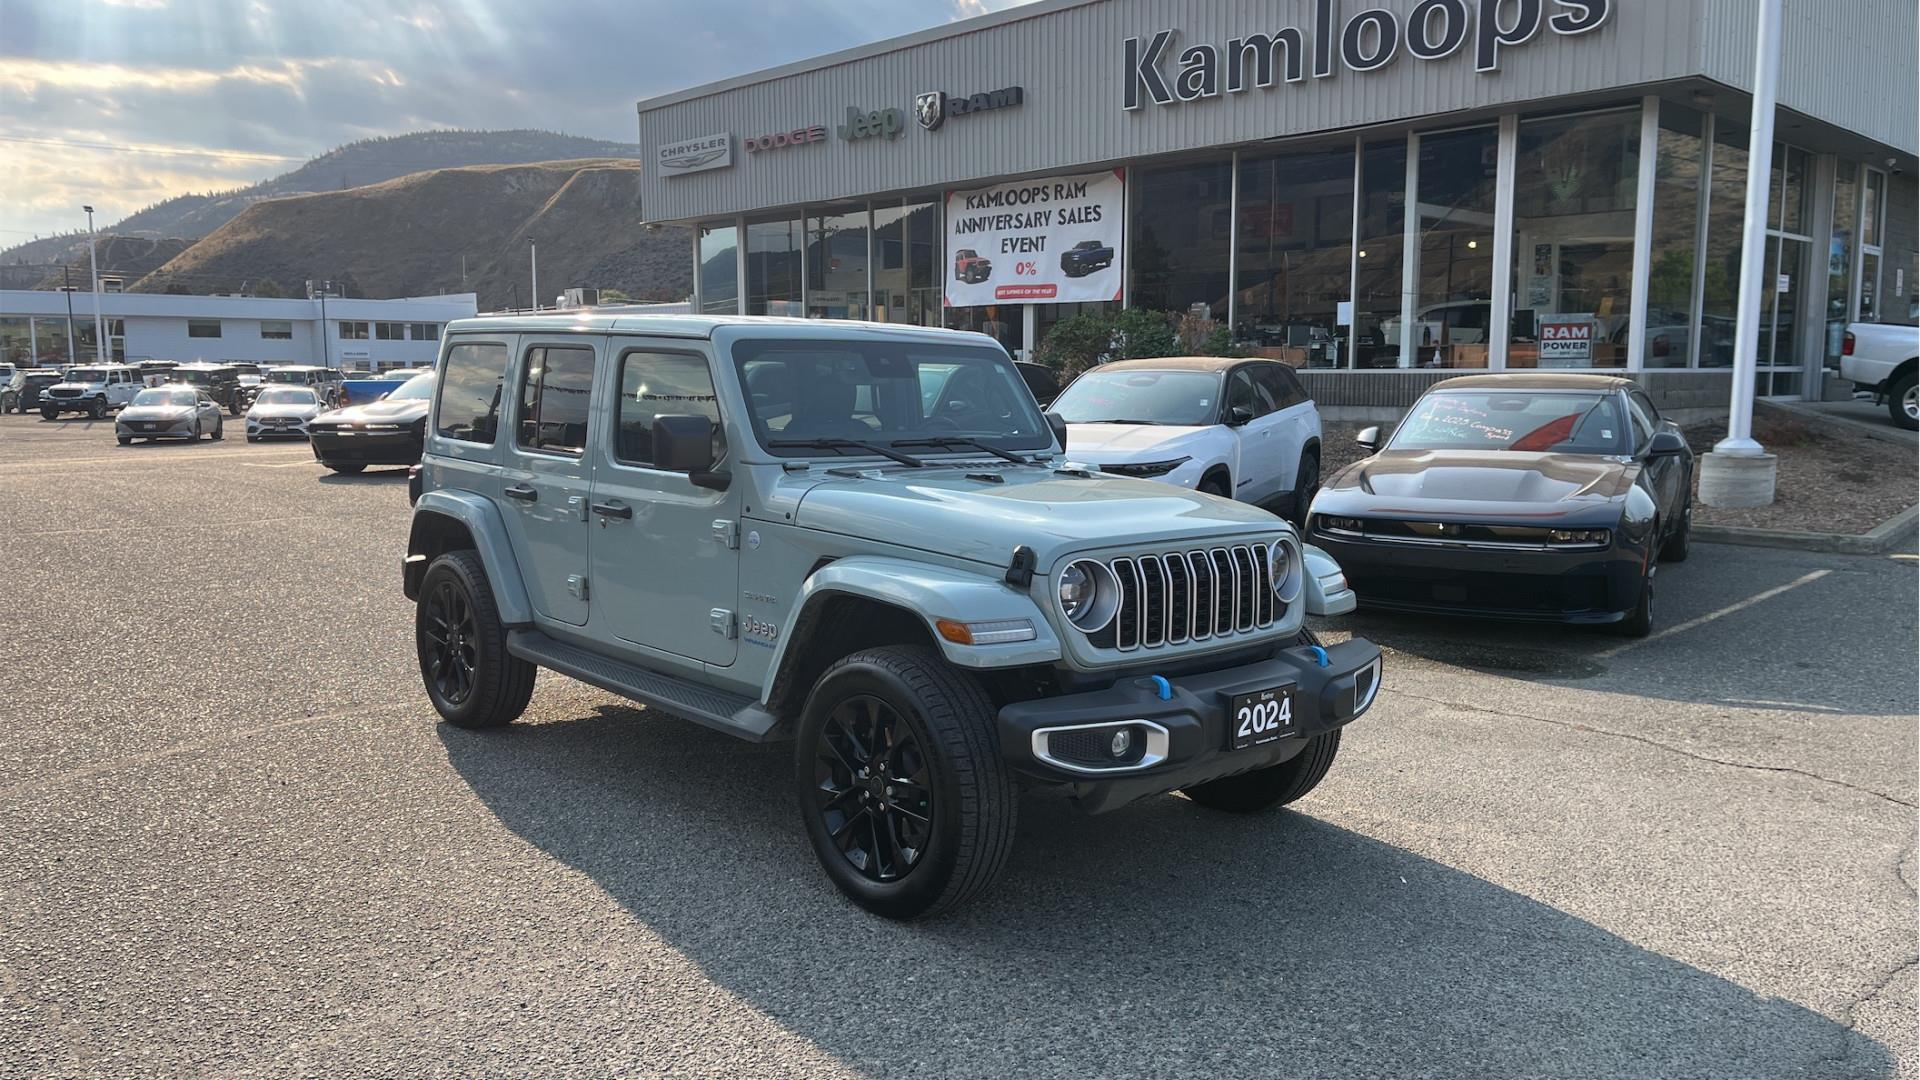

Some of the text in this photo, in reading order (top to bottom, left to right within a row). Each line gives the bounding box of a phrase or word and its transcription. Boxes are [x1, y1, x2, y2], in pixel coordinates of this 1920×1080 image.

[1122, 0, 1610, 111] Kamloops
[946, 86, 1023, 117] RAM
[837, 106, 903, 141] Jeep
[660, 138, 726, 158] CHRYSLER
[743, 125, 829, 153] DODGE
[966, 181, 1087, 210] KAMLOOPS RAM
[955, 205, 1102, 235] ANNIVERSARY SALES
[1001, 236, 1047, 254] EVENT
[1015, 261, 1037, 276] 0%
[1543, 326, 1589, 339] RAM
[1543, 341, 1588, 350] POWER
[743, 614, 778, 641] Jeep
[1237, 697, 1292, 738] 2024
